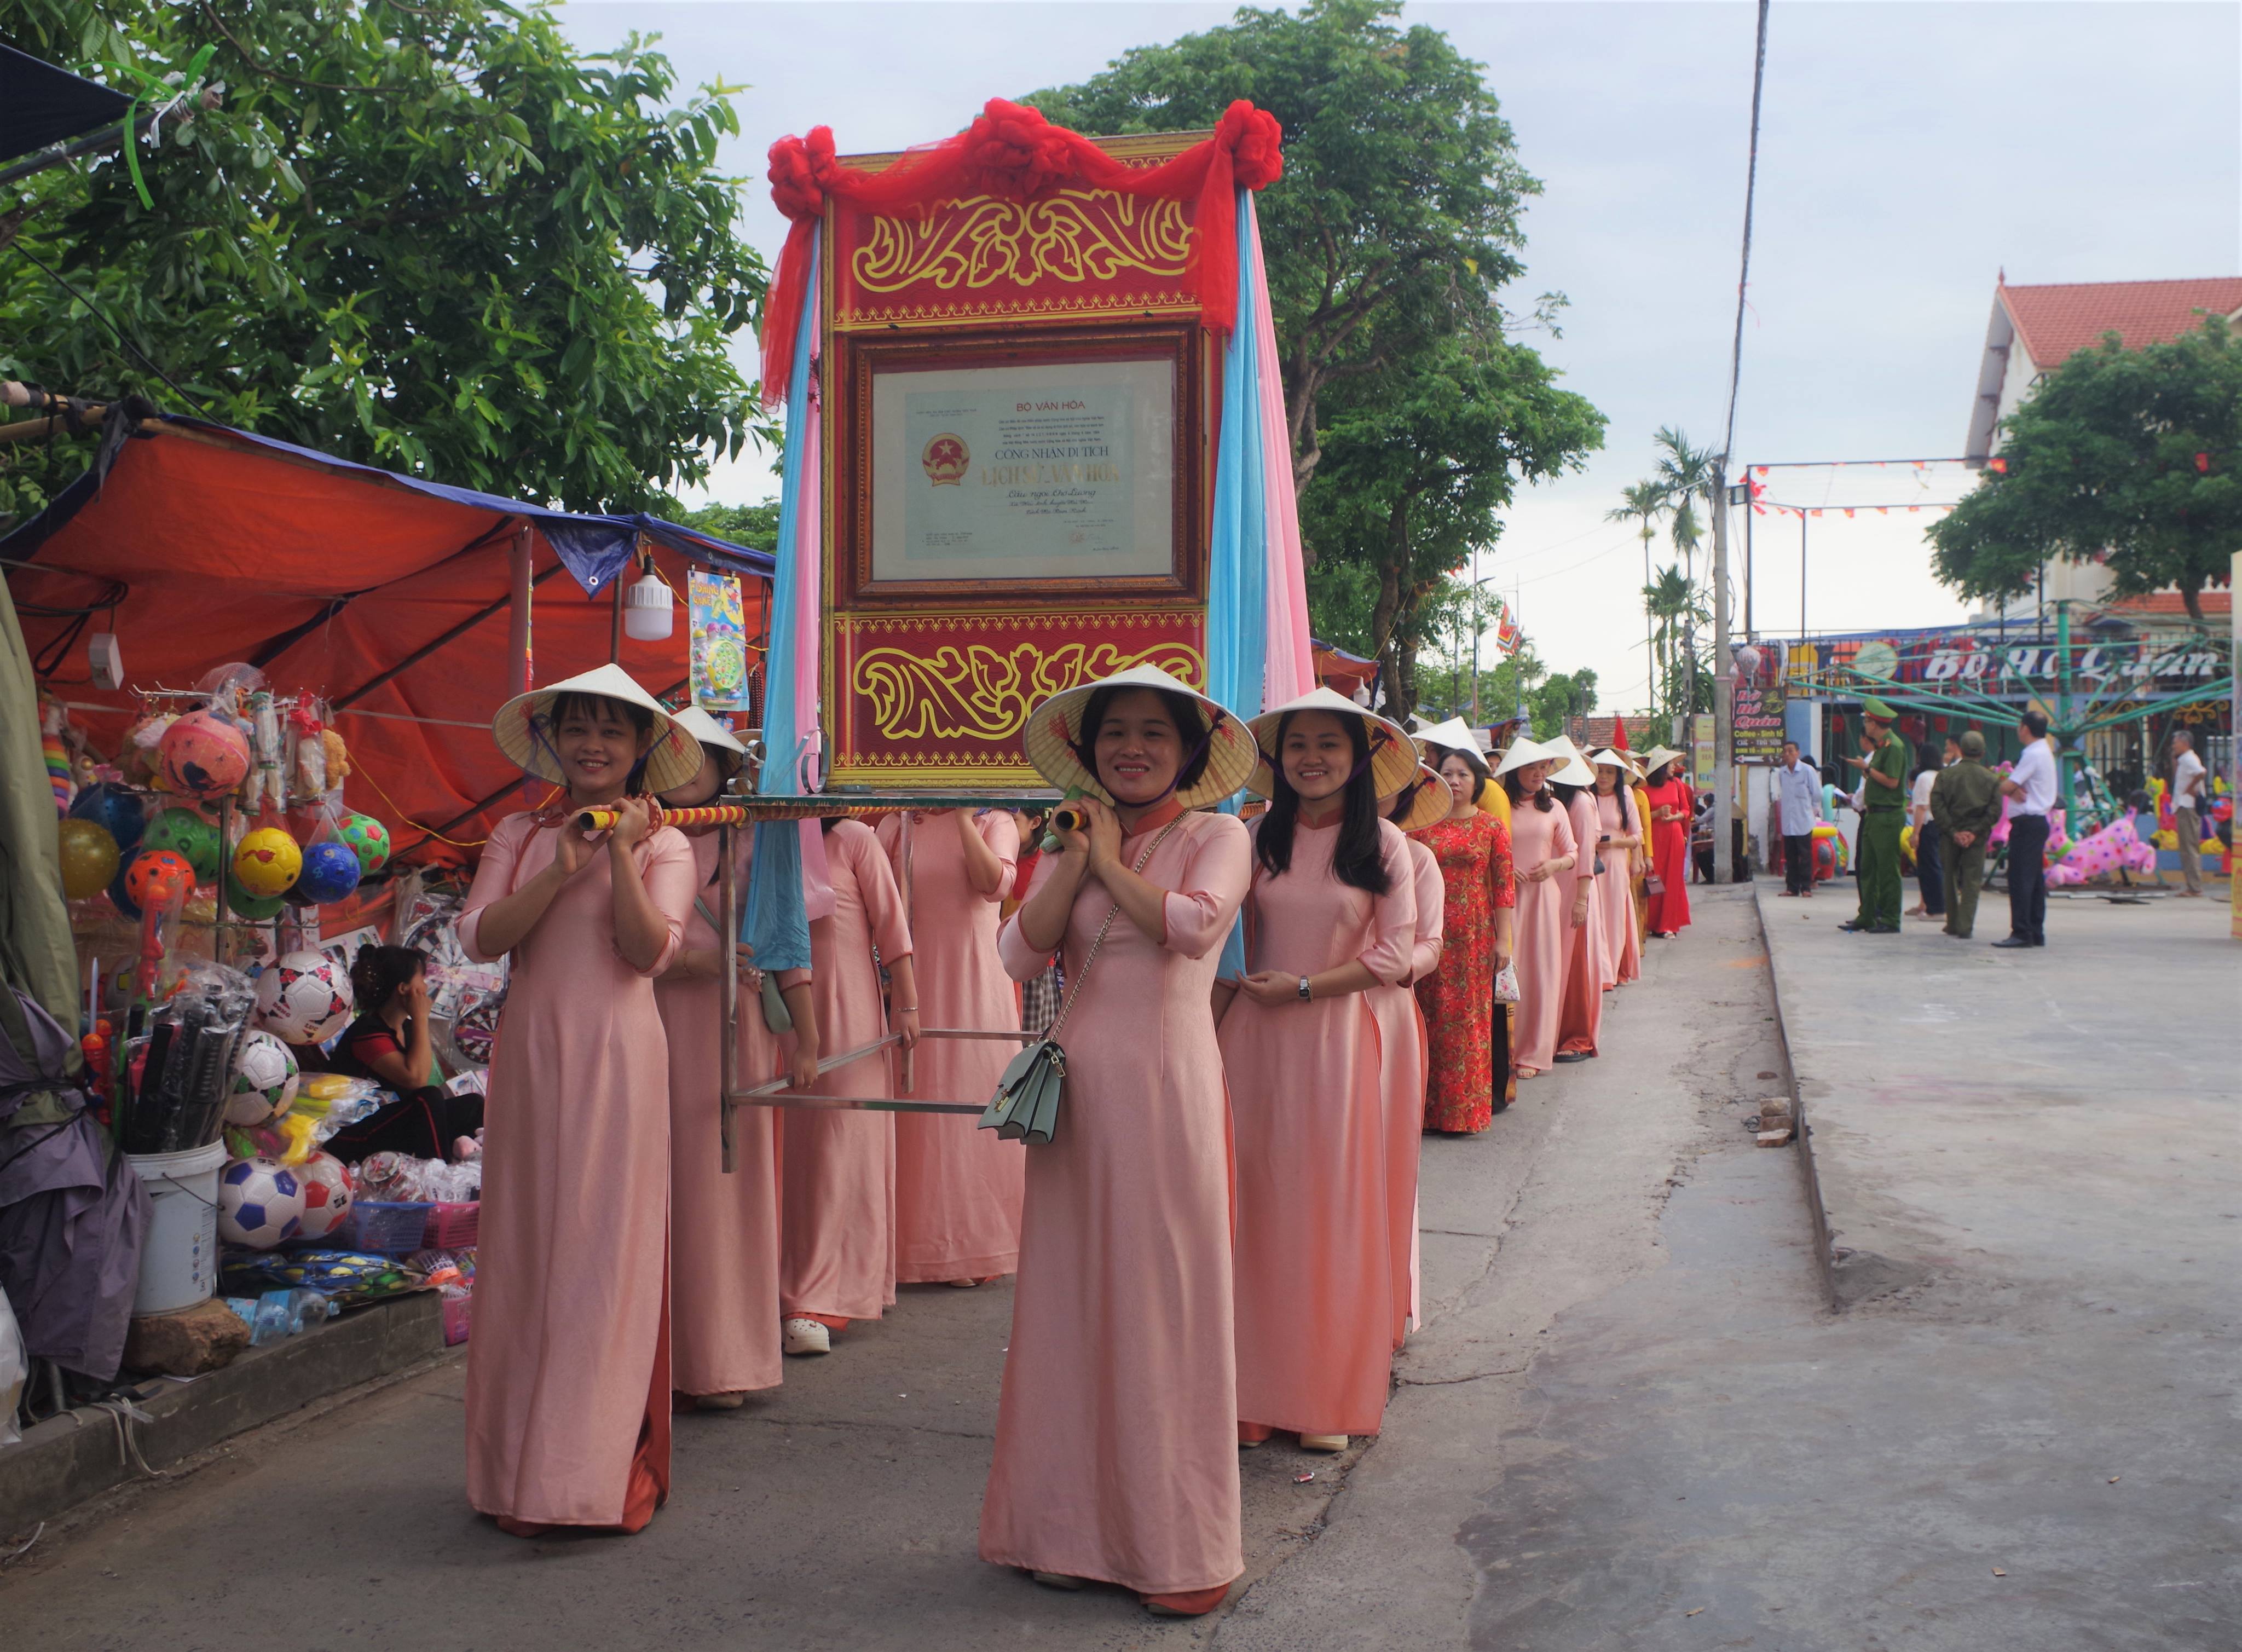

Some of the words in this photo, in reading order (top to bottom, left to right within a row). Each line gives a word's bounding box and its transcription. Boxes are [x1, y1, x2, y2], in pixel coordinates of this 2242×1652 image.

[995, 448, 1029, 460] CÔNG
[1032, 447, 1065, 459] NHẬN
[1734, 714, 1782, 729] Quán
